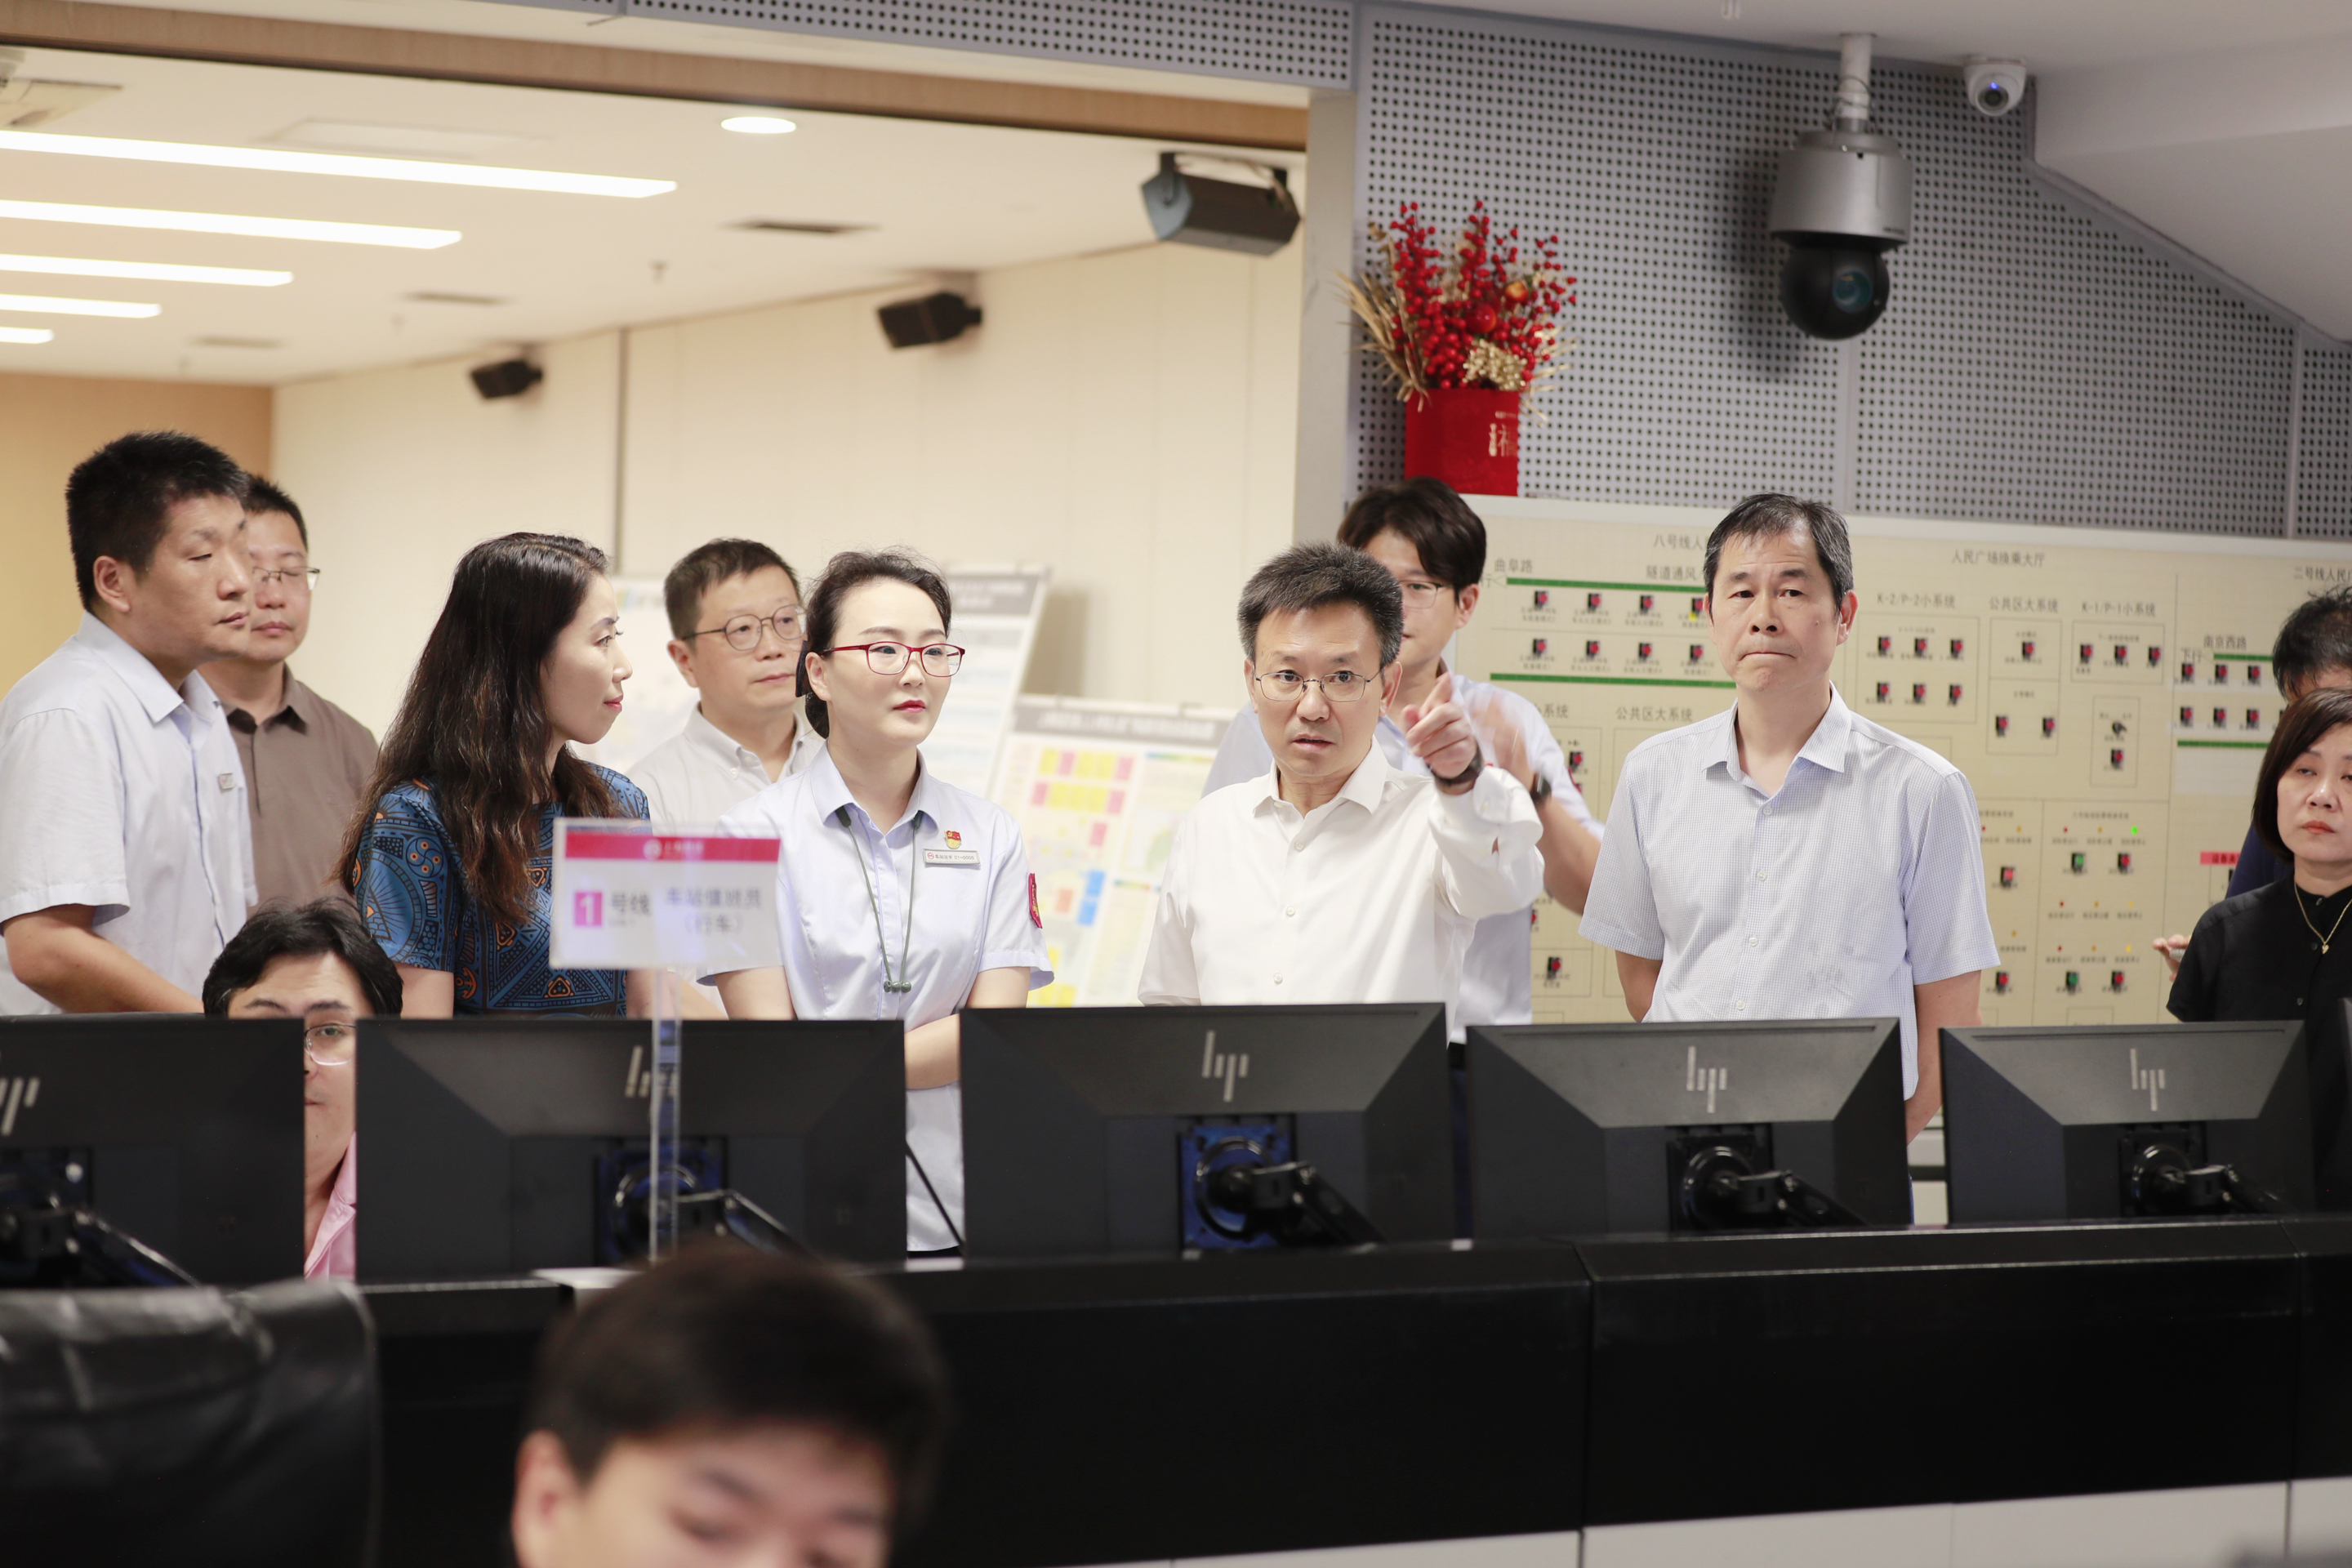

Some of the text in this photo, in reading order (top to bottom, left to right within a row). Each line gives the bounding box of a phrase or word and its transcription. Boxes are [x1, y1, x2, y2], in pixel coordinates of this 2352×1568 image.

[1653, 533, 1708, 550] 八号线人
[1494, 559, 1533, 573] 曲阜路
[1646, 565, 1704, 581] 隧道通风
[1989, 596, 2058, 612] 公共区大系统
[2203, 635, 2247, 649] 南京西路
[1616, 706, 1693, 722] 公共区大系统
[1202, 1030, 1249, 1102] hp
[1686, 1045, 1728, 1114] hp
[2130, 1049, 2165, 1111] hp
[0, 1076, 40, 1137] p
